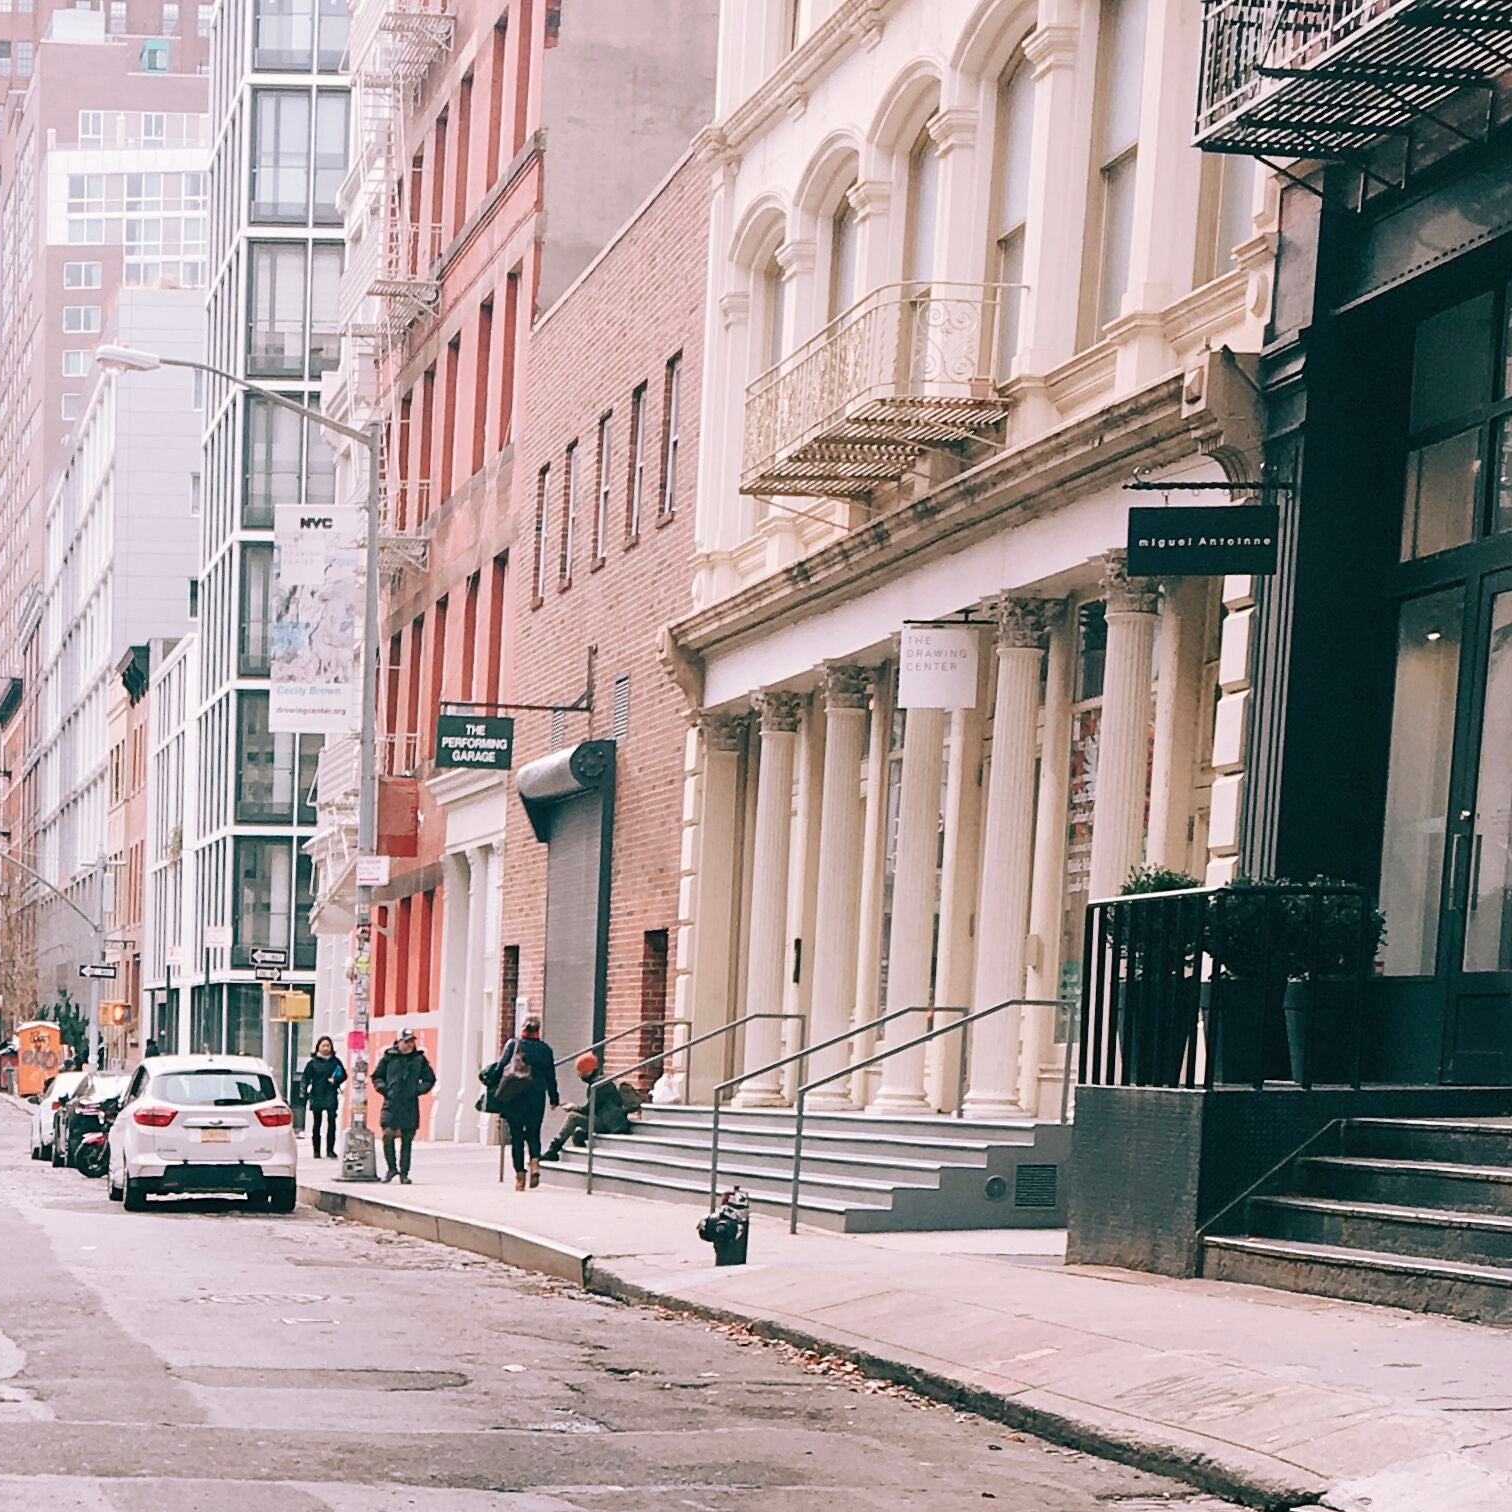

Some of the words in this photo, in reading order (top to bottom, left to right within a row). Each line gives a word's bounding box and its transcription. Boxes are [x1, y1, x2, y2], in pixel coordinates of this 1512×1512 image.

[300, 517, 333, 529] NYC
[1138, 537, 1193, 548] miguel
[1199, 537, 1272, 547] Antoinne
[907, 635, 932, 646] THE
[906, 648, 968, 659] DRAWING
[905, 662, 958, 672] CENTER
[276, 685, 306, 696] Cecily
[309, 686, 341, 696] Brown
[465, 724, 486, 736] THE
[441, 737, 507, 750] PERFORMING
[452, 750, 496, 763] GARAGE
